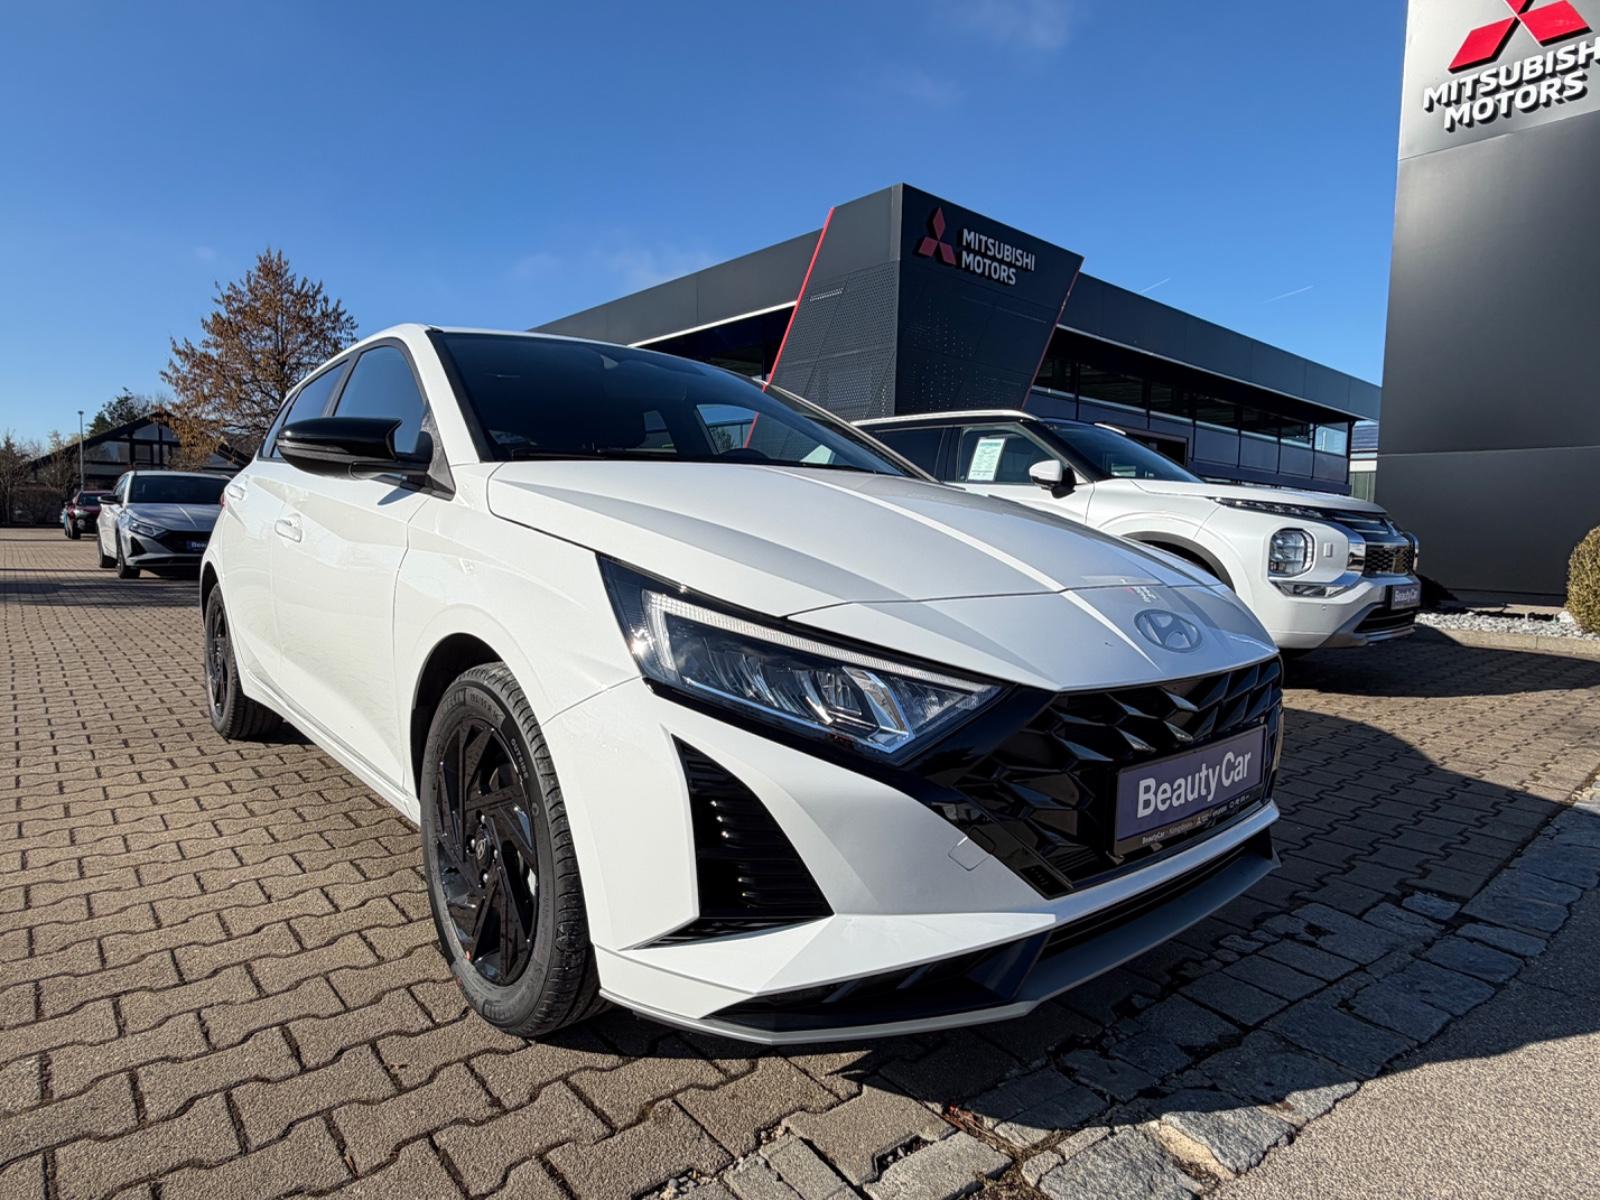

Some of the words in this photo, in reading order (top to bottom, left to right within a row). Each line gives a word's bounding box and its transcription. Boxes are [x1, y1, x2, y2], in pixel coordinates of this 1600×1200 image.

[1443, 71, 1586, 131] MOTORS
[961, 251, 1017, 286] MOTORS
[962, 228, 1036, 272] MITSUBISHI
[510, 738, 529, 779] OUTSIDE
